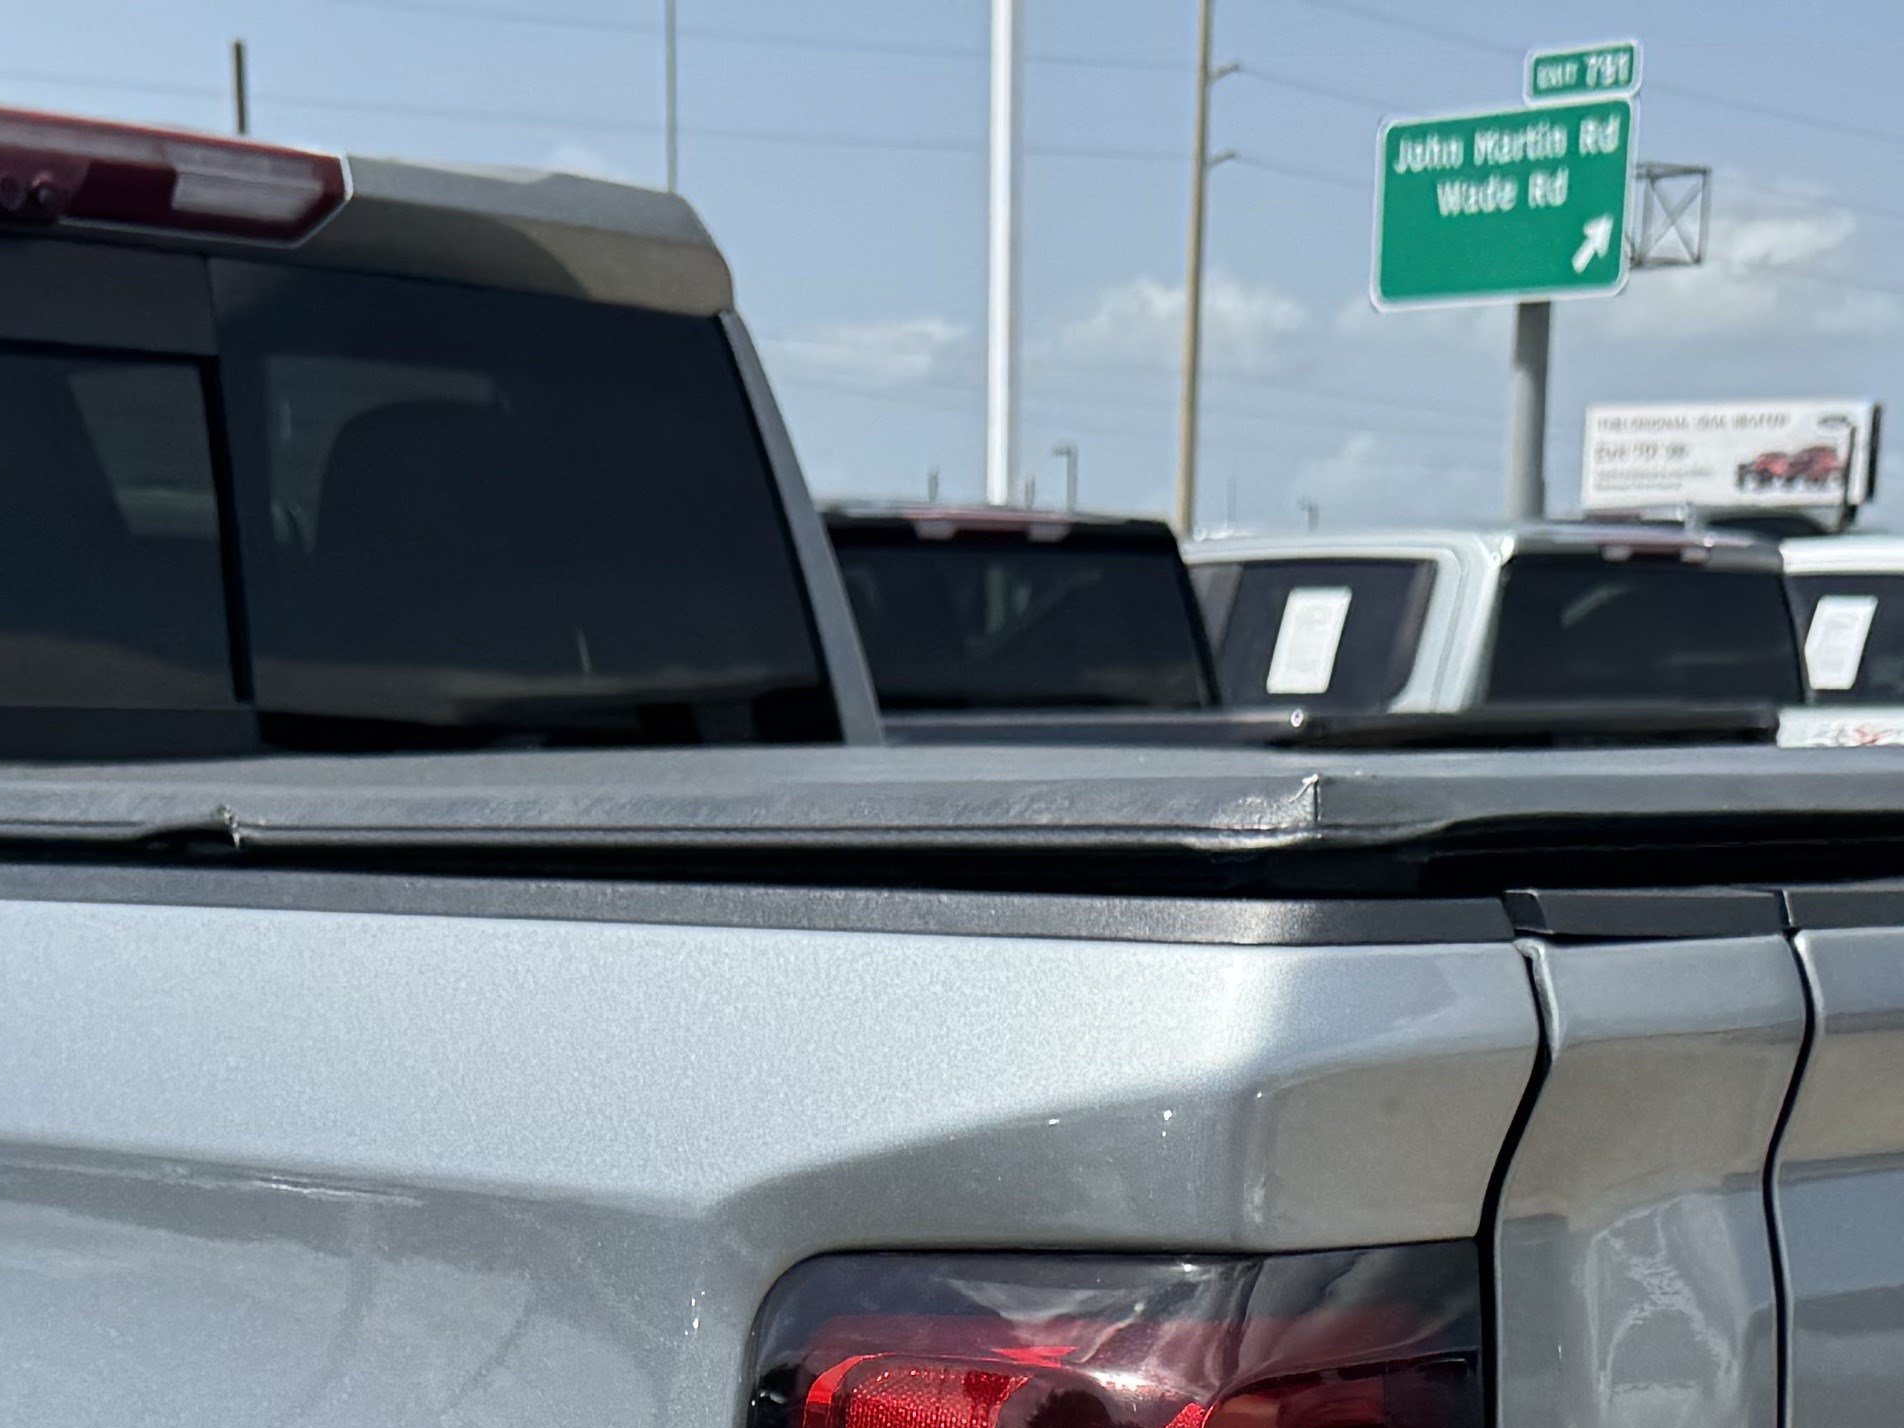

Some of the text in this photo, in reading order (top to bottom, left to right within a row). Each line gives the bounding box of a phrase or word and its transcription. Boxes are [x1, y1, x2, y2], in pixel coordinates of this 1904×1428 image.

[1394, 113, 1621, 174] John Martin Rd
[1437, 164, 1569, 217] Wade Rd
